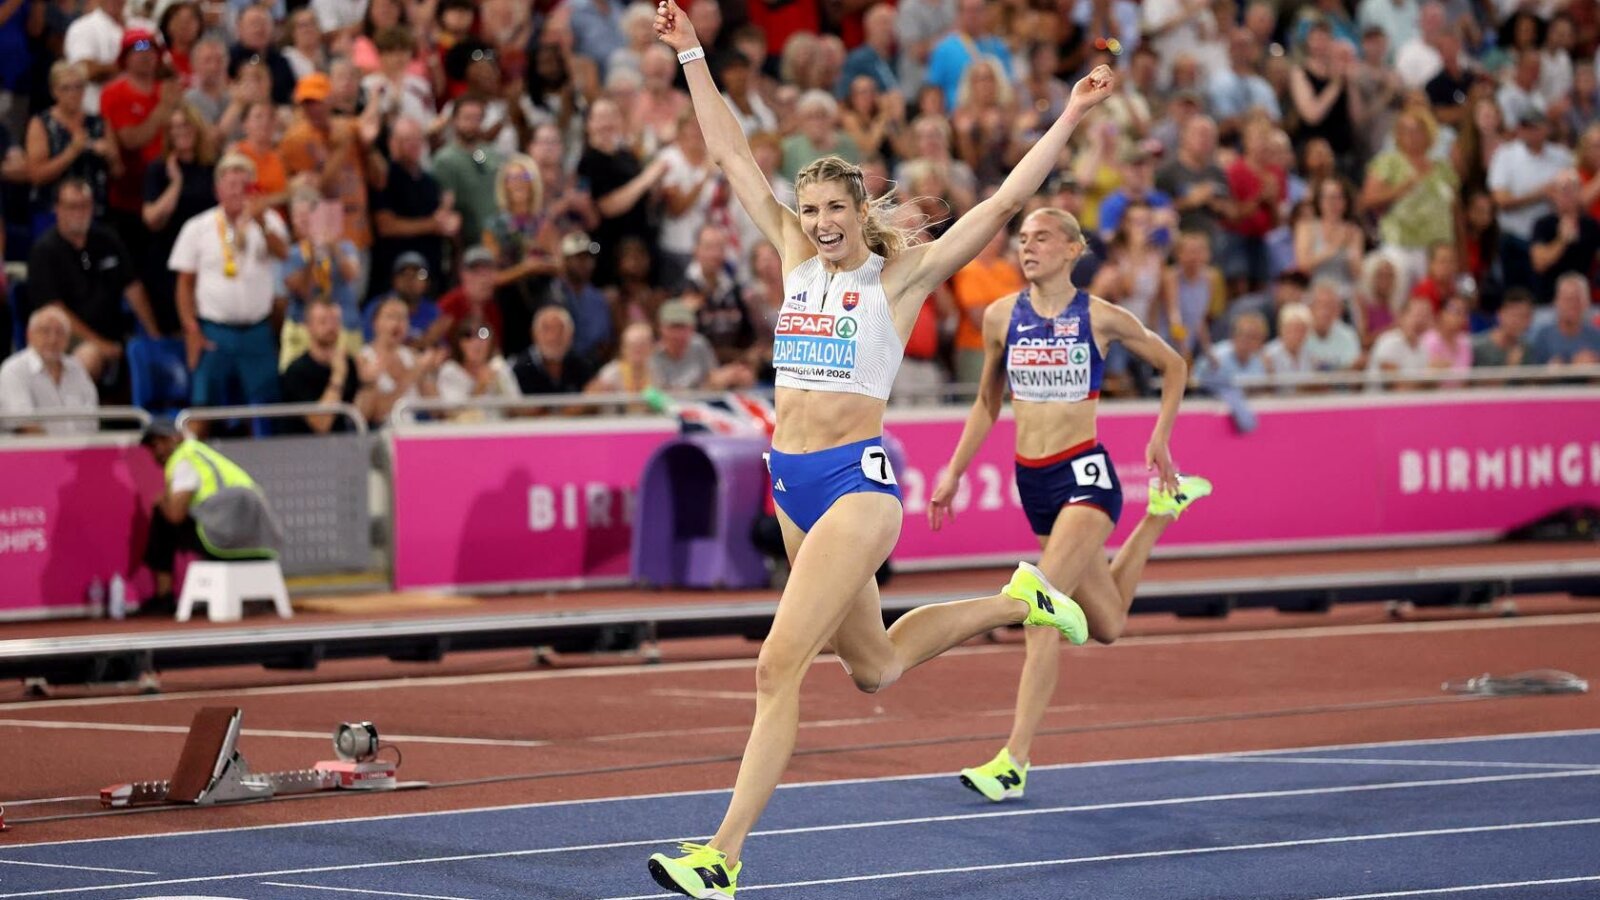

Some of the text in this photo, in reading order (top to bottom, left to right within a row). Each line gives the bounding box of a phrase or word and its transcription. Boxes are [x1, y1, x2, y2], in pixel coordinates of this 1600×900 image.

[778, 315, 834, 334] SPAR
[774, 339, 855, 366] ZAPLETALOVÁ
[1012, 349, 1067, 365] SPAR
[826, 369, 851, 379] 2026
[1010, 368, 1088, 387] NEWNHAM
[869, 452, 888, 480] 7
[1084, 462, 1100, 484] 9
